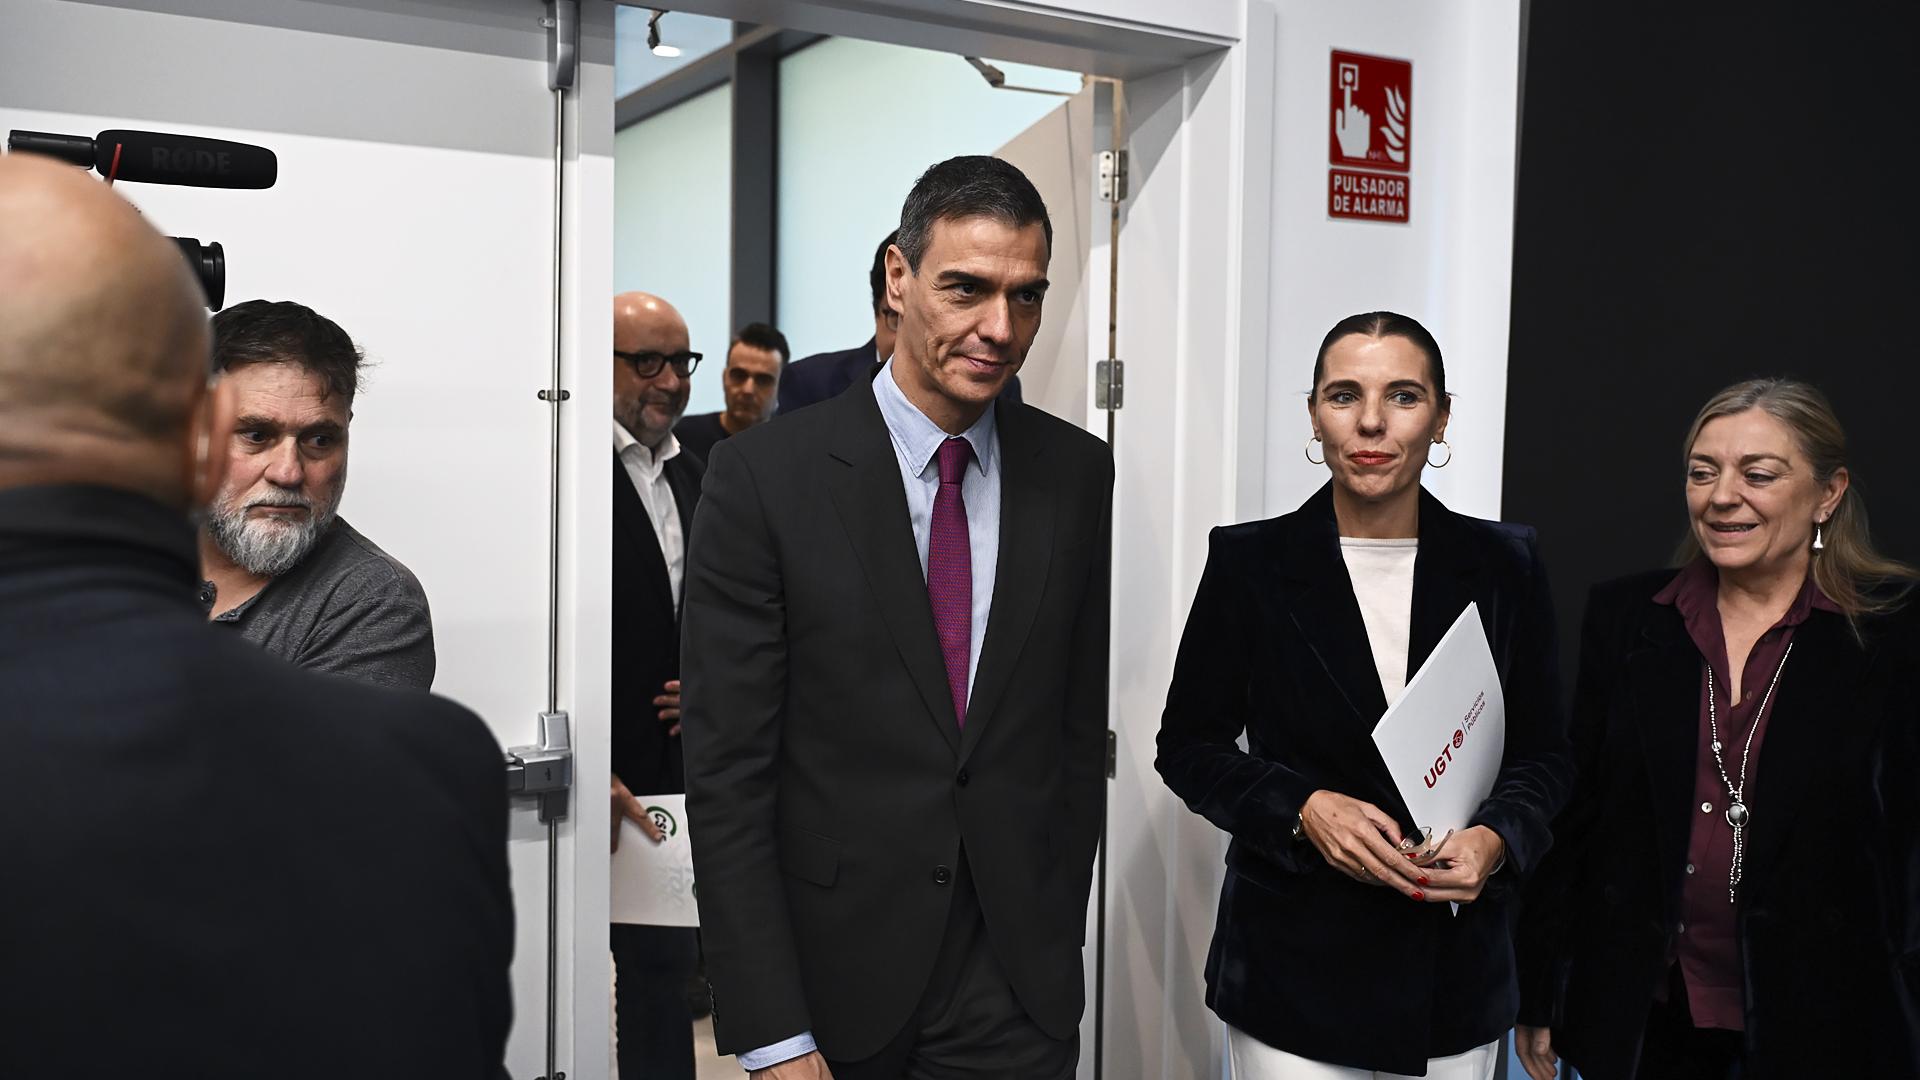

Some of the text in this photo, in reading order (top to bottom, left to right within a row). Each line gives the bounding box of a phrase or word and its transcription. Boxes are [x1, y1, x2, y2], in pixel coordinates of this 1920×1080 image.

[1333, 174, 1405, 198] PULSADOR
[1333, 195, 1405, 217] DE ALARMA
[1463, 690, 1485, 723] Servicios
[1424, 743, 1453, 788] UGT
